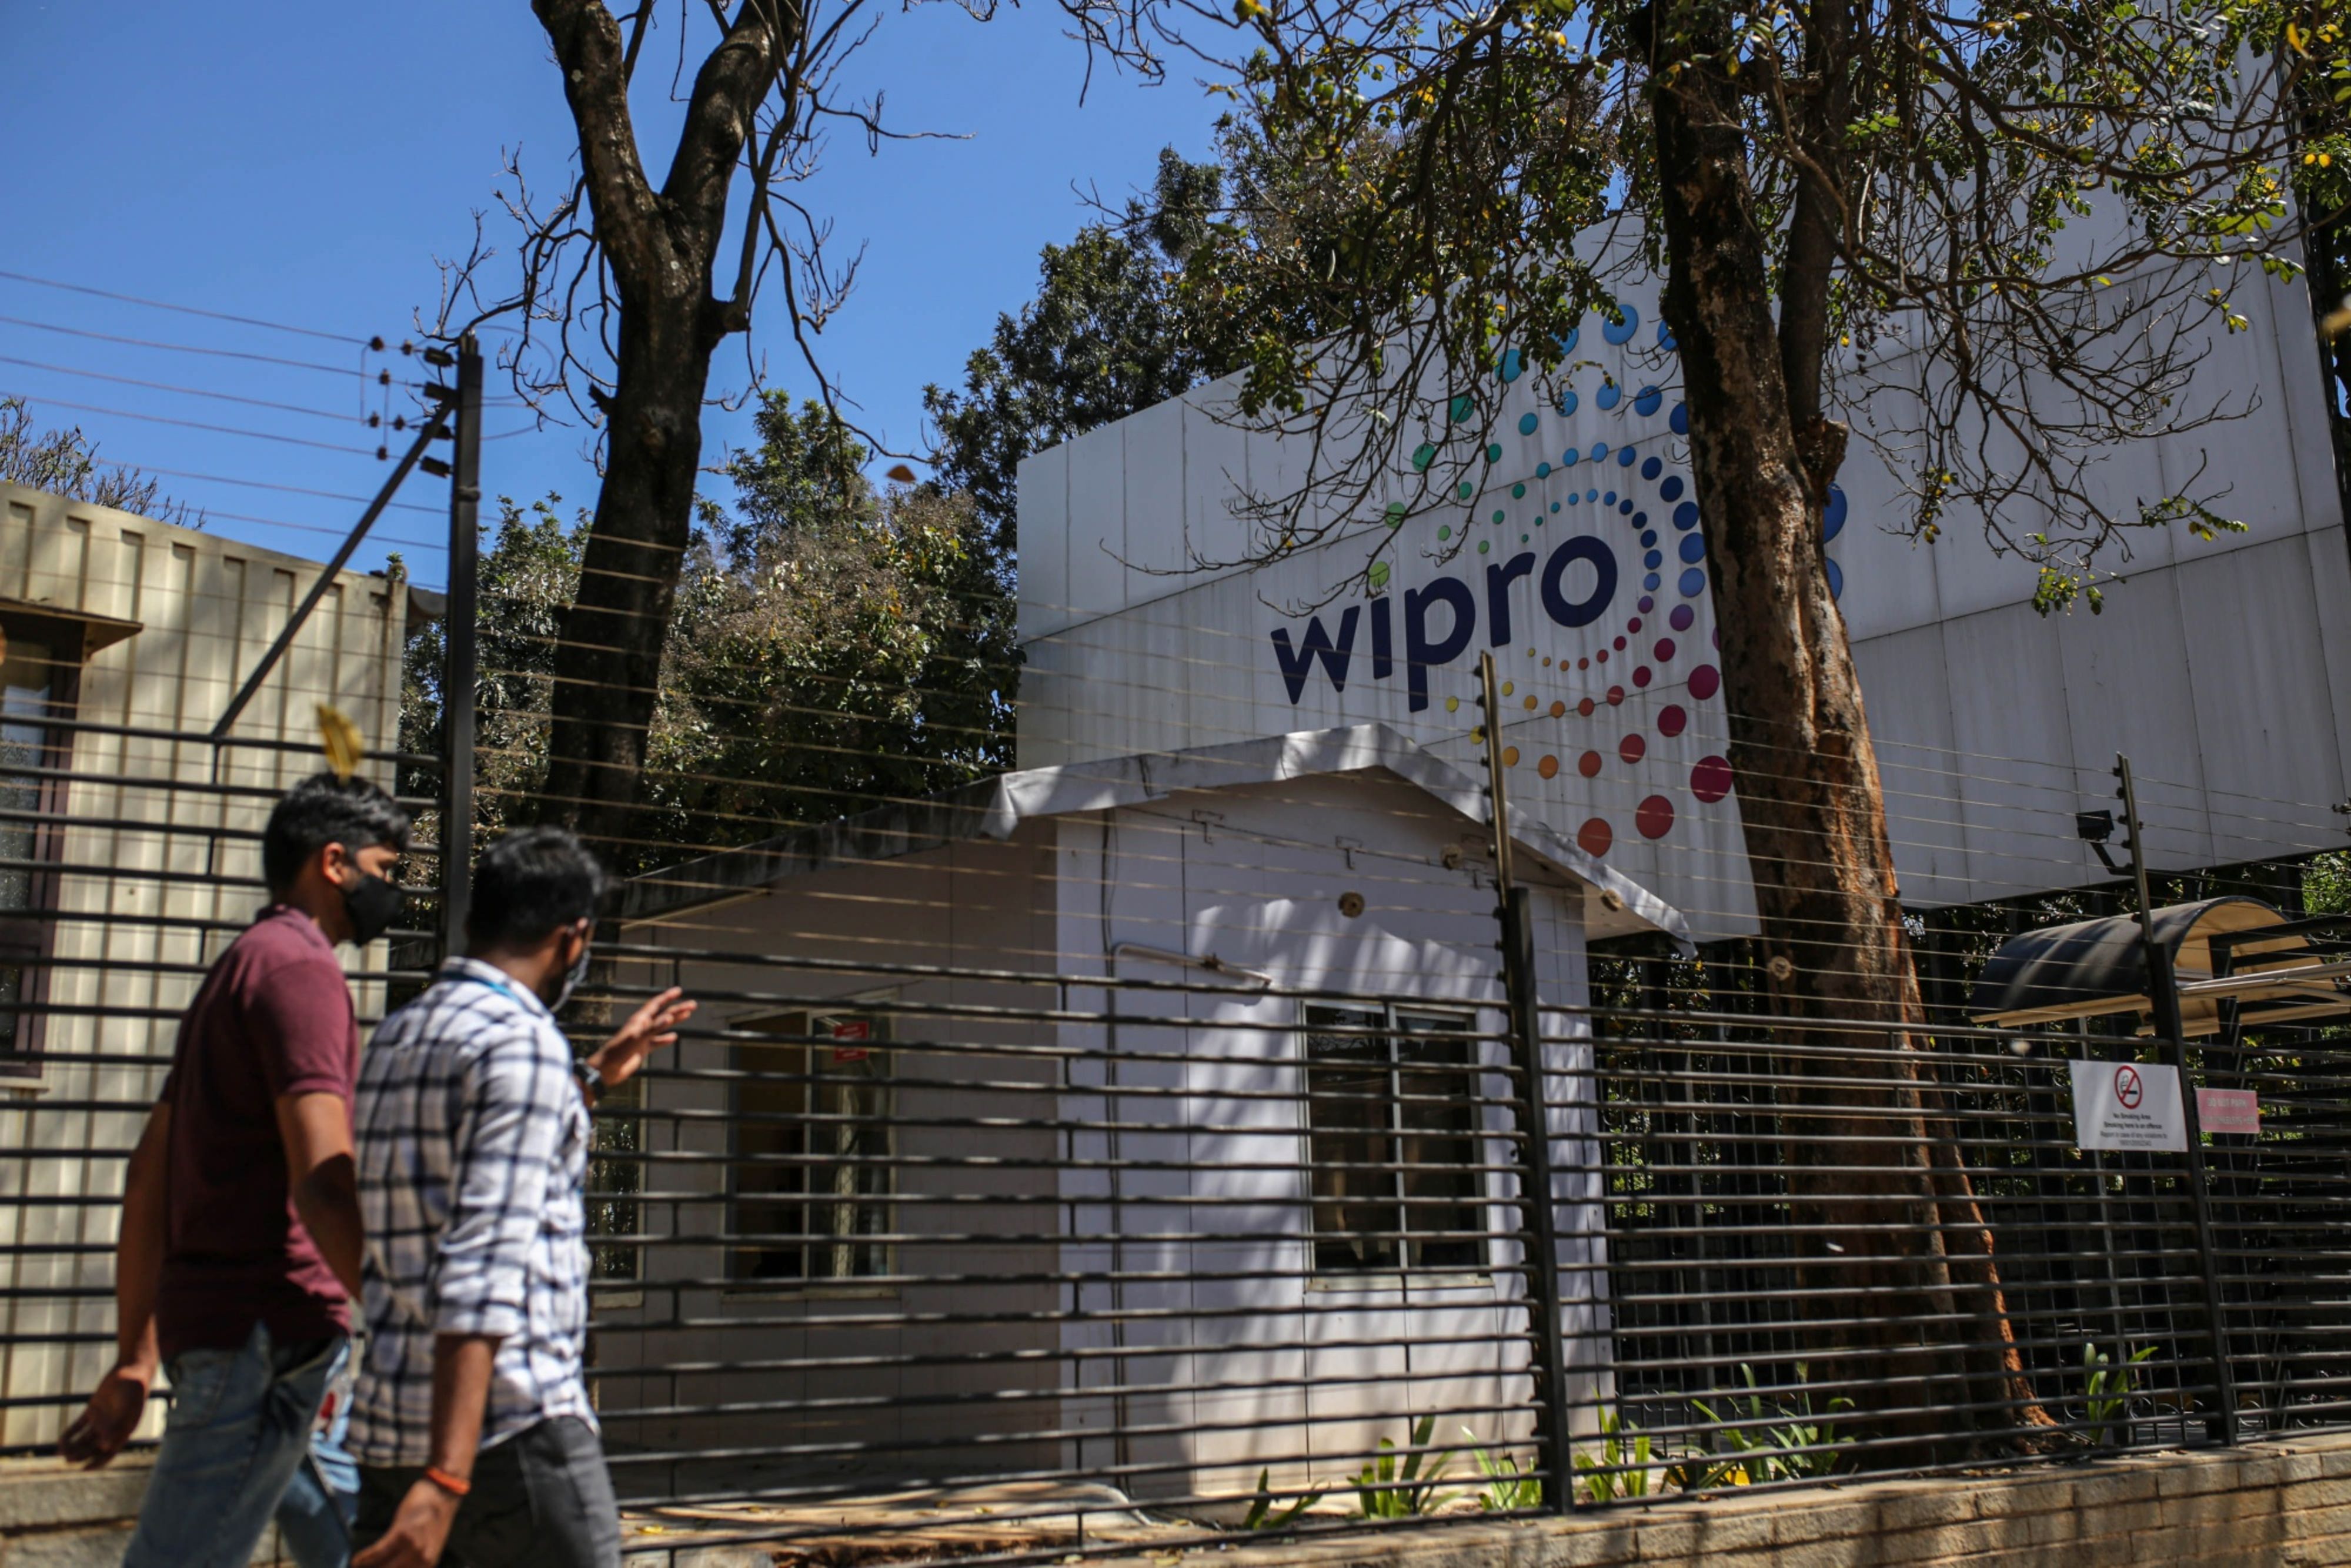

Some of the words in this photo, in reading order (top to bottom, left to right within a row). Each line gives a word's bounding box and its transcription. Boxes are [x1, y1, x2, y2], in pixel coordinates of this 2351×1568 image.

[1270, 535, 1618, 713] wipro
[2120, 1112, 2140, 1121] Smoking
[2104, 1121, 2124, 1129] Smoking
